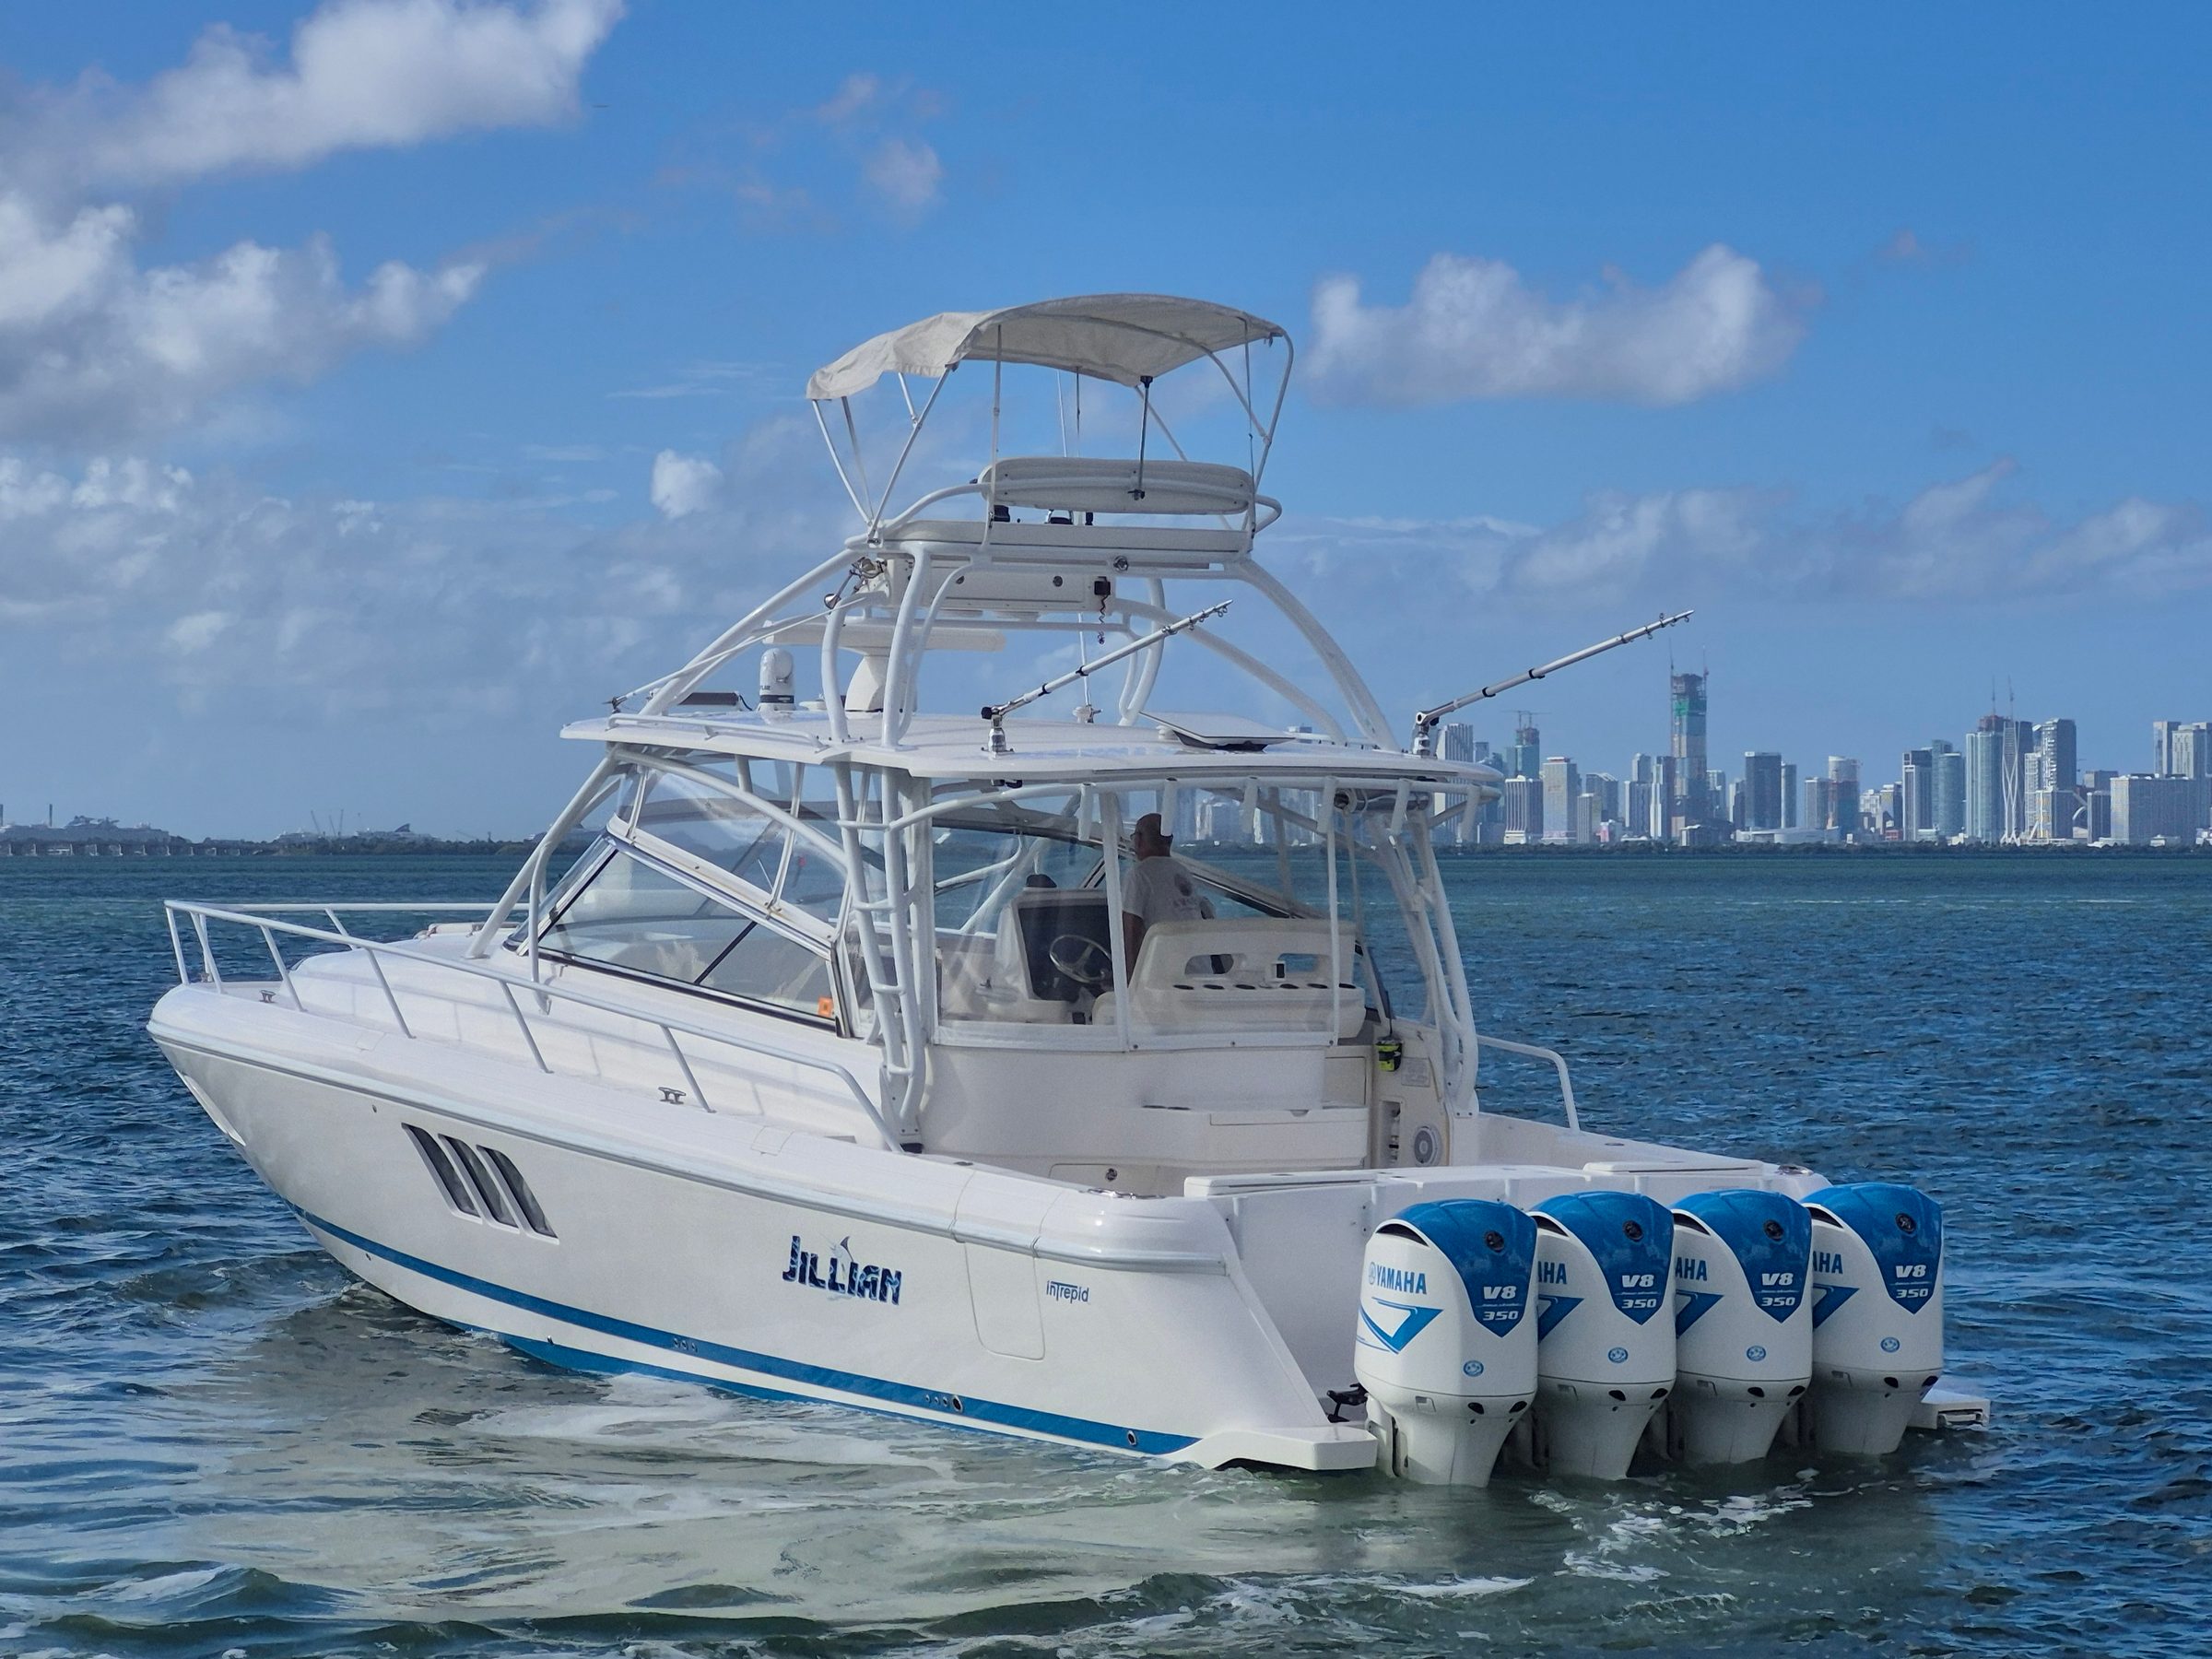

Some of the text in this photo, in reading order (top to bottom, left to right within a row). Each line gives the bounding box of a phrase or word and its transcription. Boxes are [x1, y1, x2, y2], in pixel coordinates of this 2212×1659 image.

[782, 1235, 902, 1305] JILLIAN
[1895, 1265, 1926, 1278] V8
[1376, 1265, 1428, 1295] YAMAHA
[1621, 1274, 1655, 1288] V8
[1761, 1272, 1794, 1287] V8
[1483, 1285, 1517, 1300] V8
[1895, 1288, 1929, 1299] 350
[1621, 1299, 1657, 1309] 350
[1760, 1297, 1795, 1307] 350
[1482, 1311, 1519, 1321] 350
